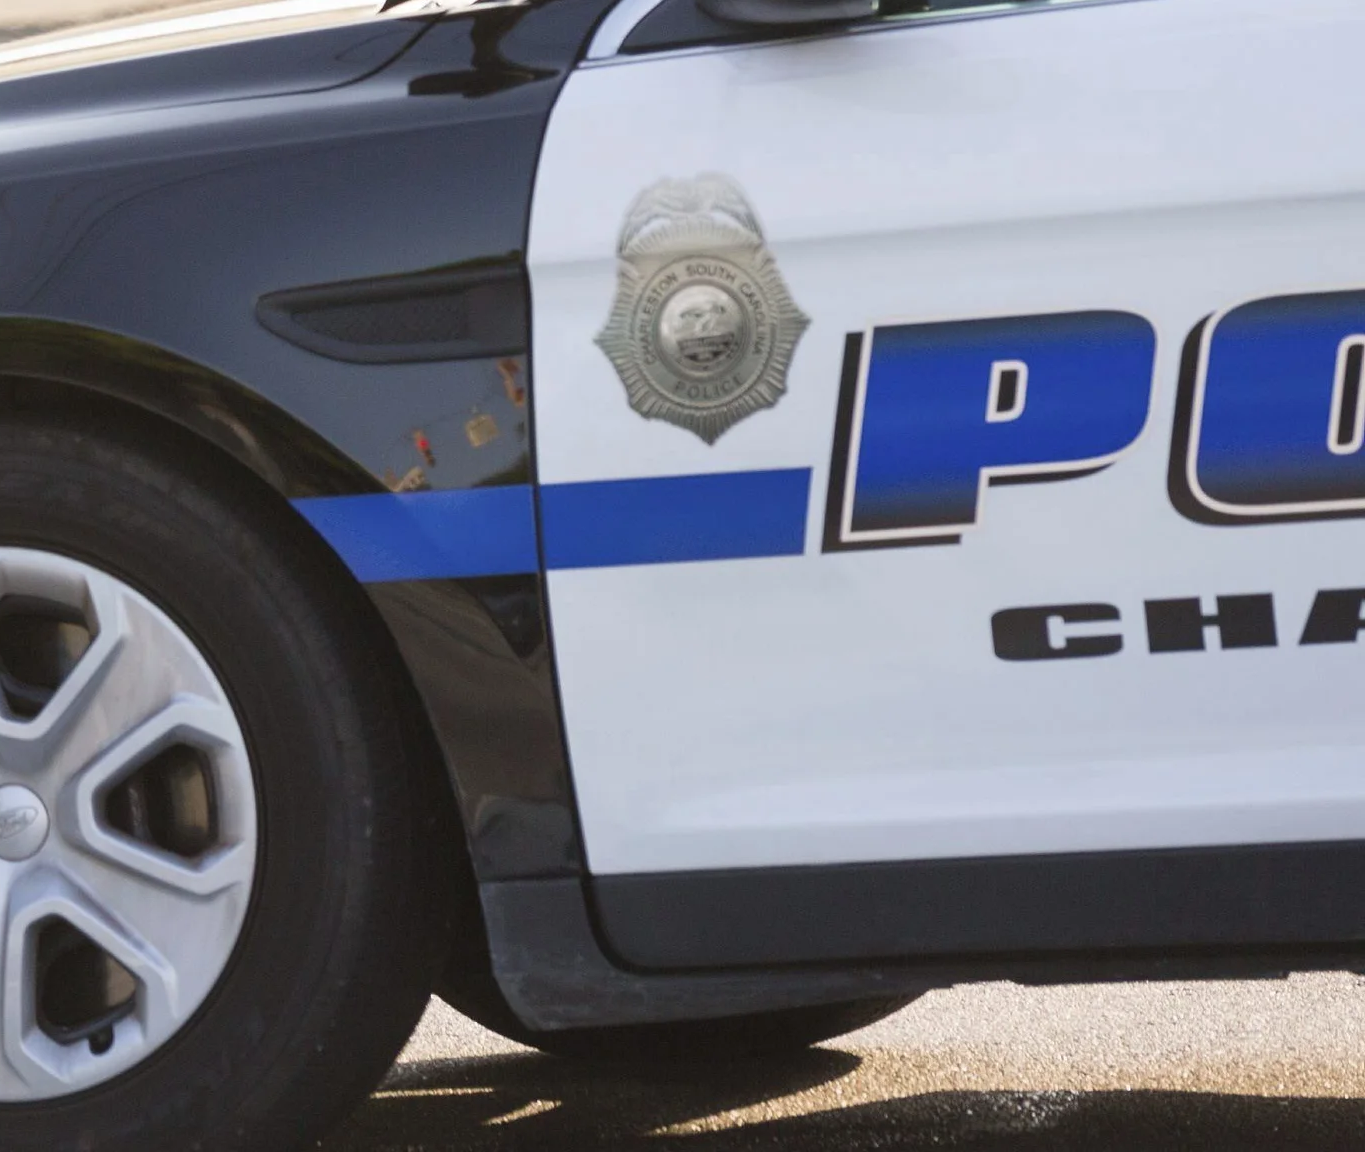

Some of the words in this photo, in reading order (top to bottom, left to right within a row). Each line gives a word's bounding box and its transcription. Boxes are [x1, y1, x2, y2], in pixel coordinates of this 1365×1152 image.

[639, 272, 679, 366] CHARLESTON
[685, 262, 737, 284] SOUTH
[740, 281, 767, 356] CAROLINA
[675, 374, 744, 399] POLICE
